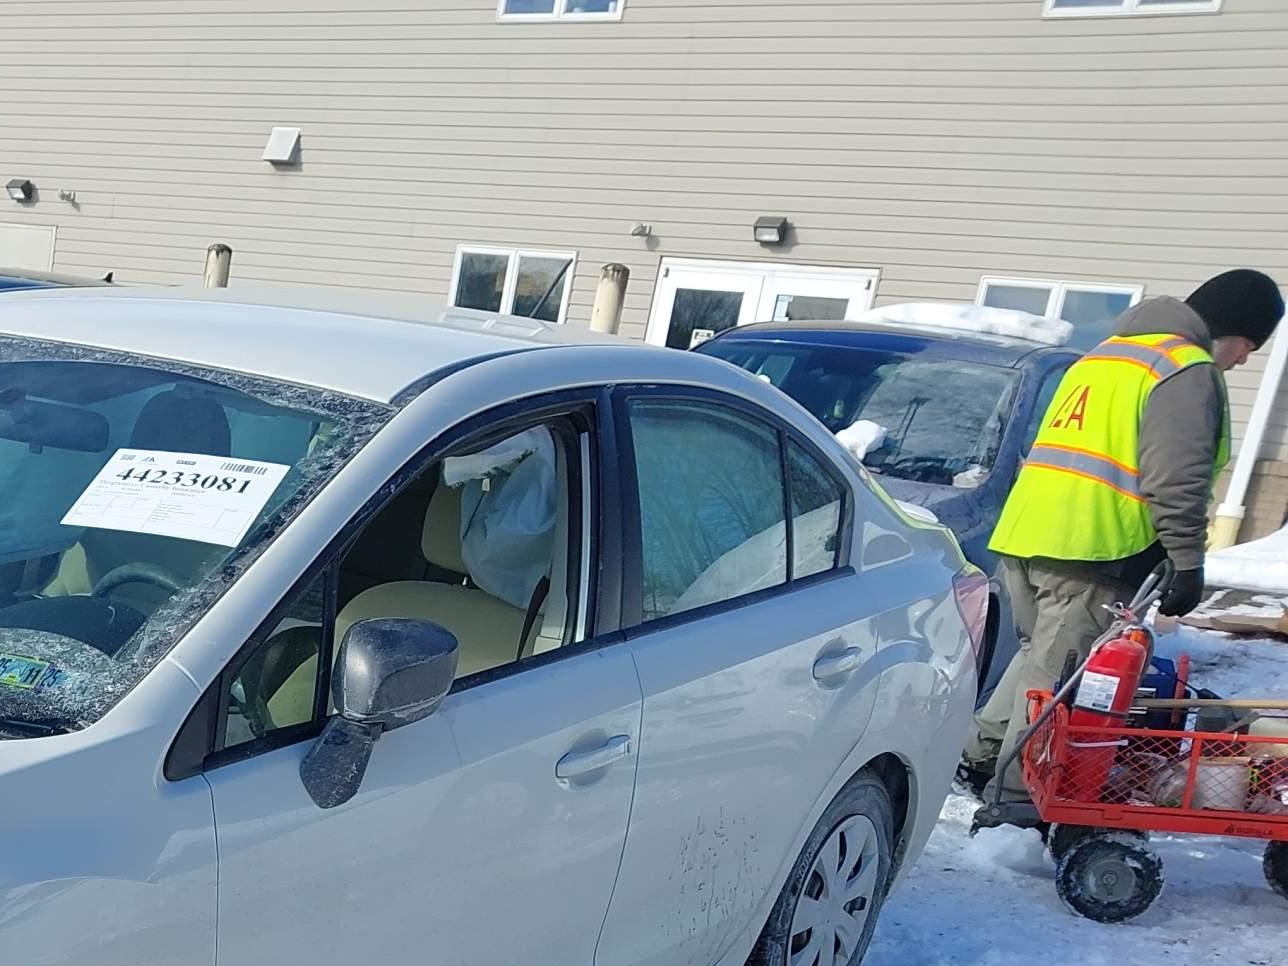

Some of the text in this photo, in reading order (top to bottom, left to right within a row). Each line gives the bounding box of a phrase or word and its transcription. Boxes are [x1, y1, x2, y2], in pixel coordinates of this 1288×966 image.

[116, 467, 251, 494] 44233081
[23, 667, 42, 685] 11
[41, 667, 62, 687] 25
